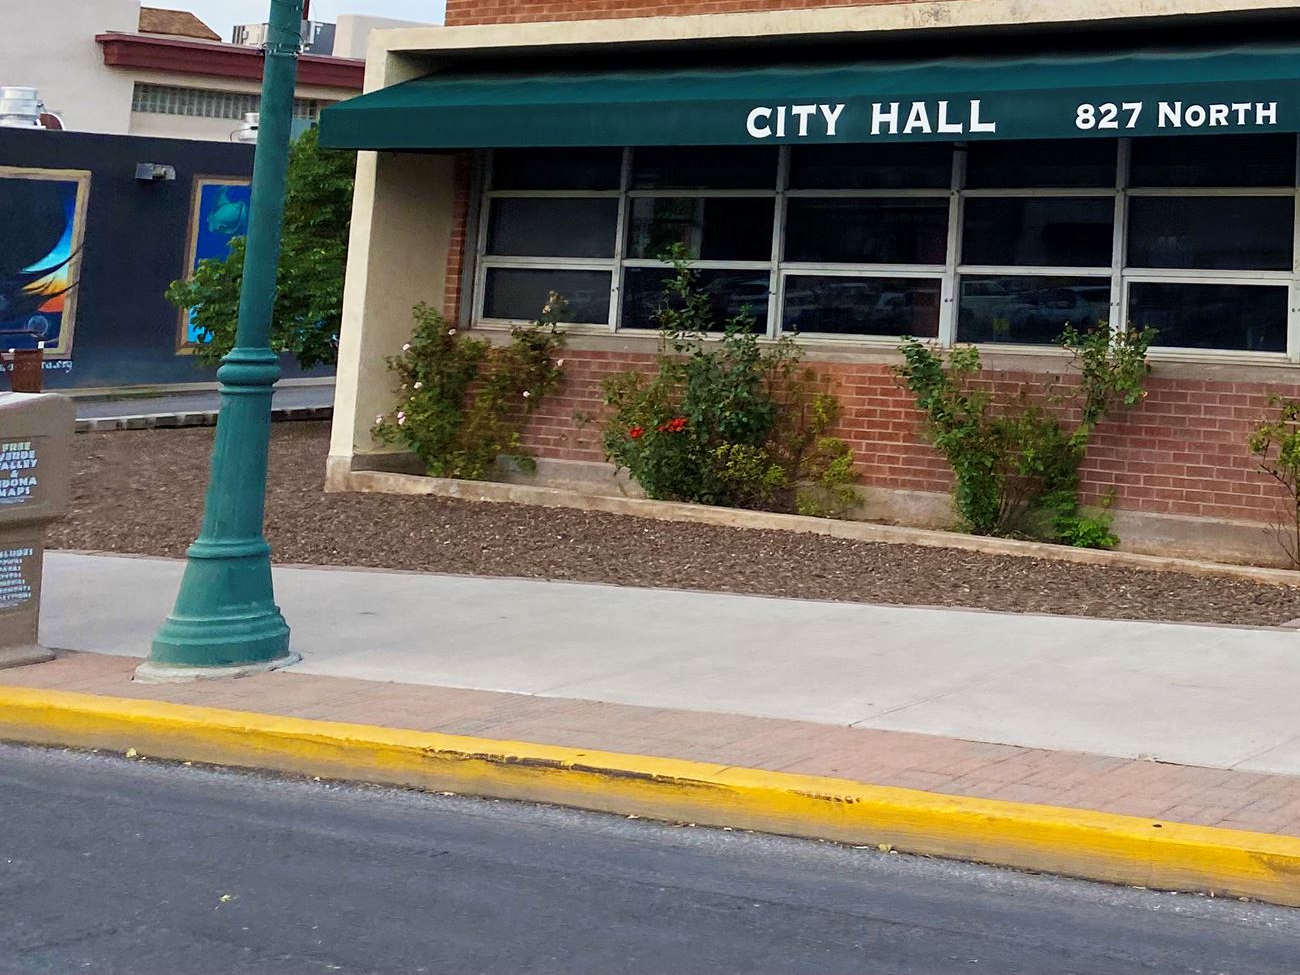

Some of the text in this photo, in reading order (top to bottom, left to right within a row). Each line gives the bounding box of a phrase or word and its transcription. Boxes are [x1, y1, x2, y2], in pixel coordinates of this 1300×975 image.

[746, 99, 997, 139] CITY HALL
[1075, 101, 1143, 131] 827
[1157, 100, 1278, 128] NORTH
[0, 459, 38, 471] ALLEY
[0, 477, 38, 488] DONA
